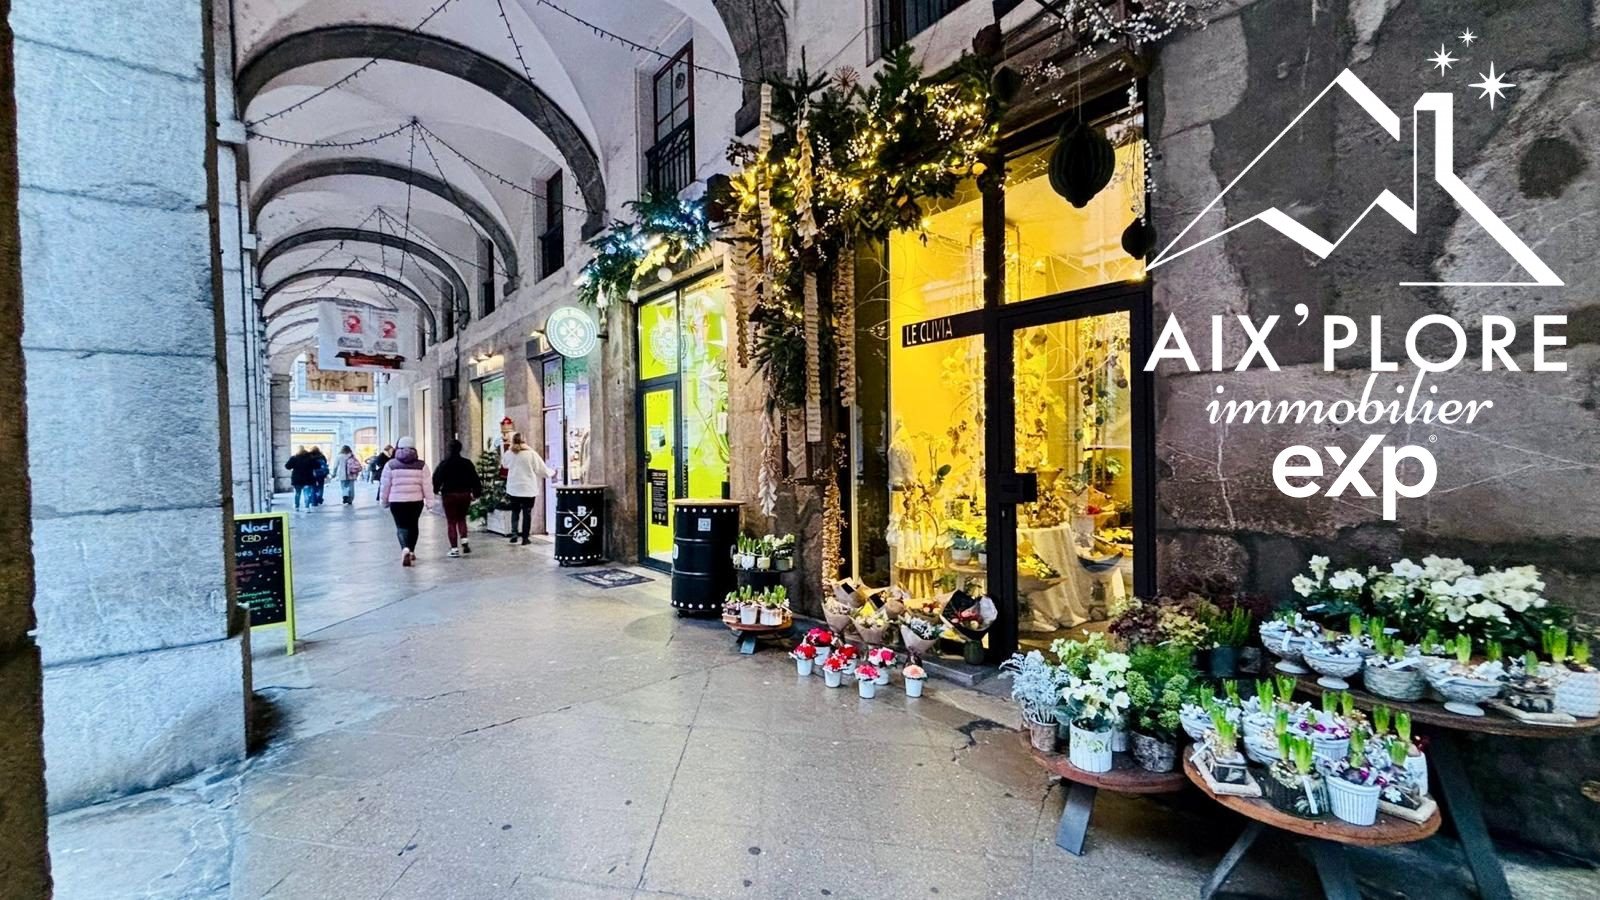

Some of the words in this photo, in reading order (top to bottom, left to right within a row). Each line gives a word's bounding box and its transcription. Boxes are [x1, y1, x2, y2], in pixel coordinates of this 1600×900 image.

[906, 325, 917, 345] LE
[920, 317, 953, 342] CLIVIA
[240, 534, 262, 543] CBD
